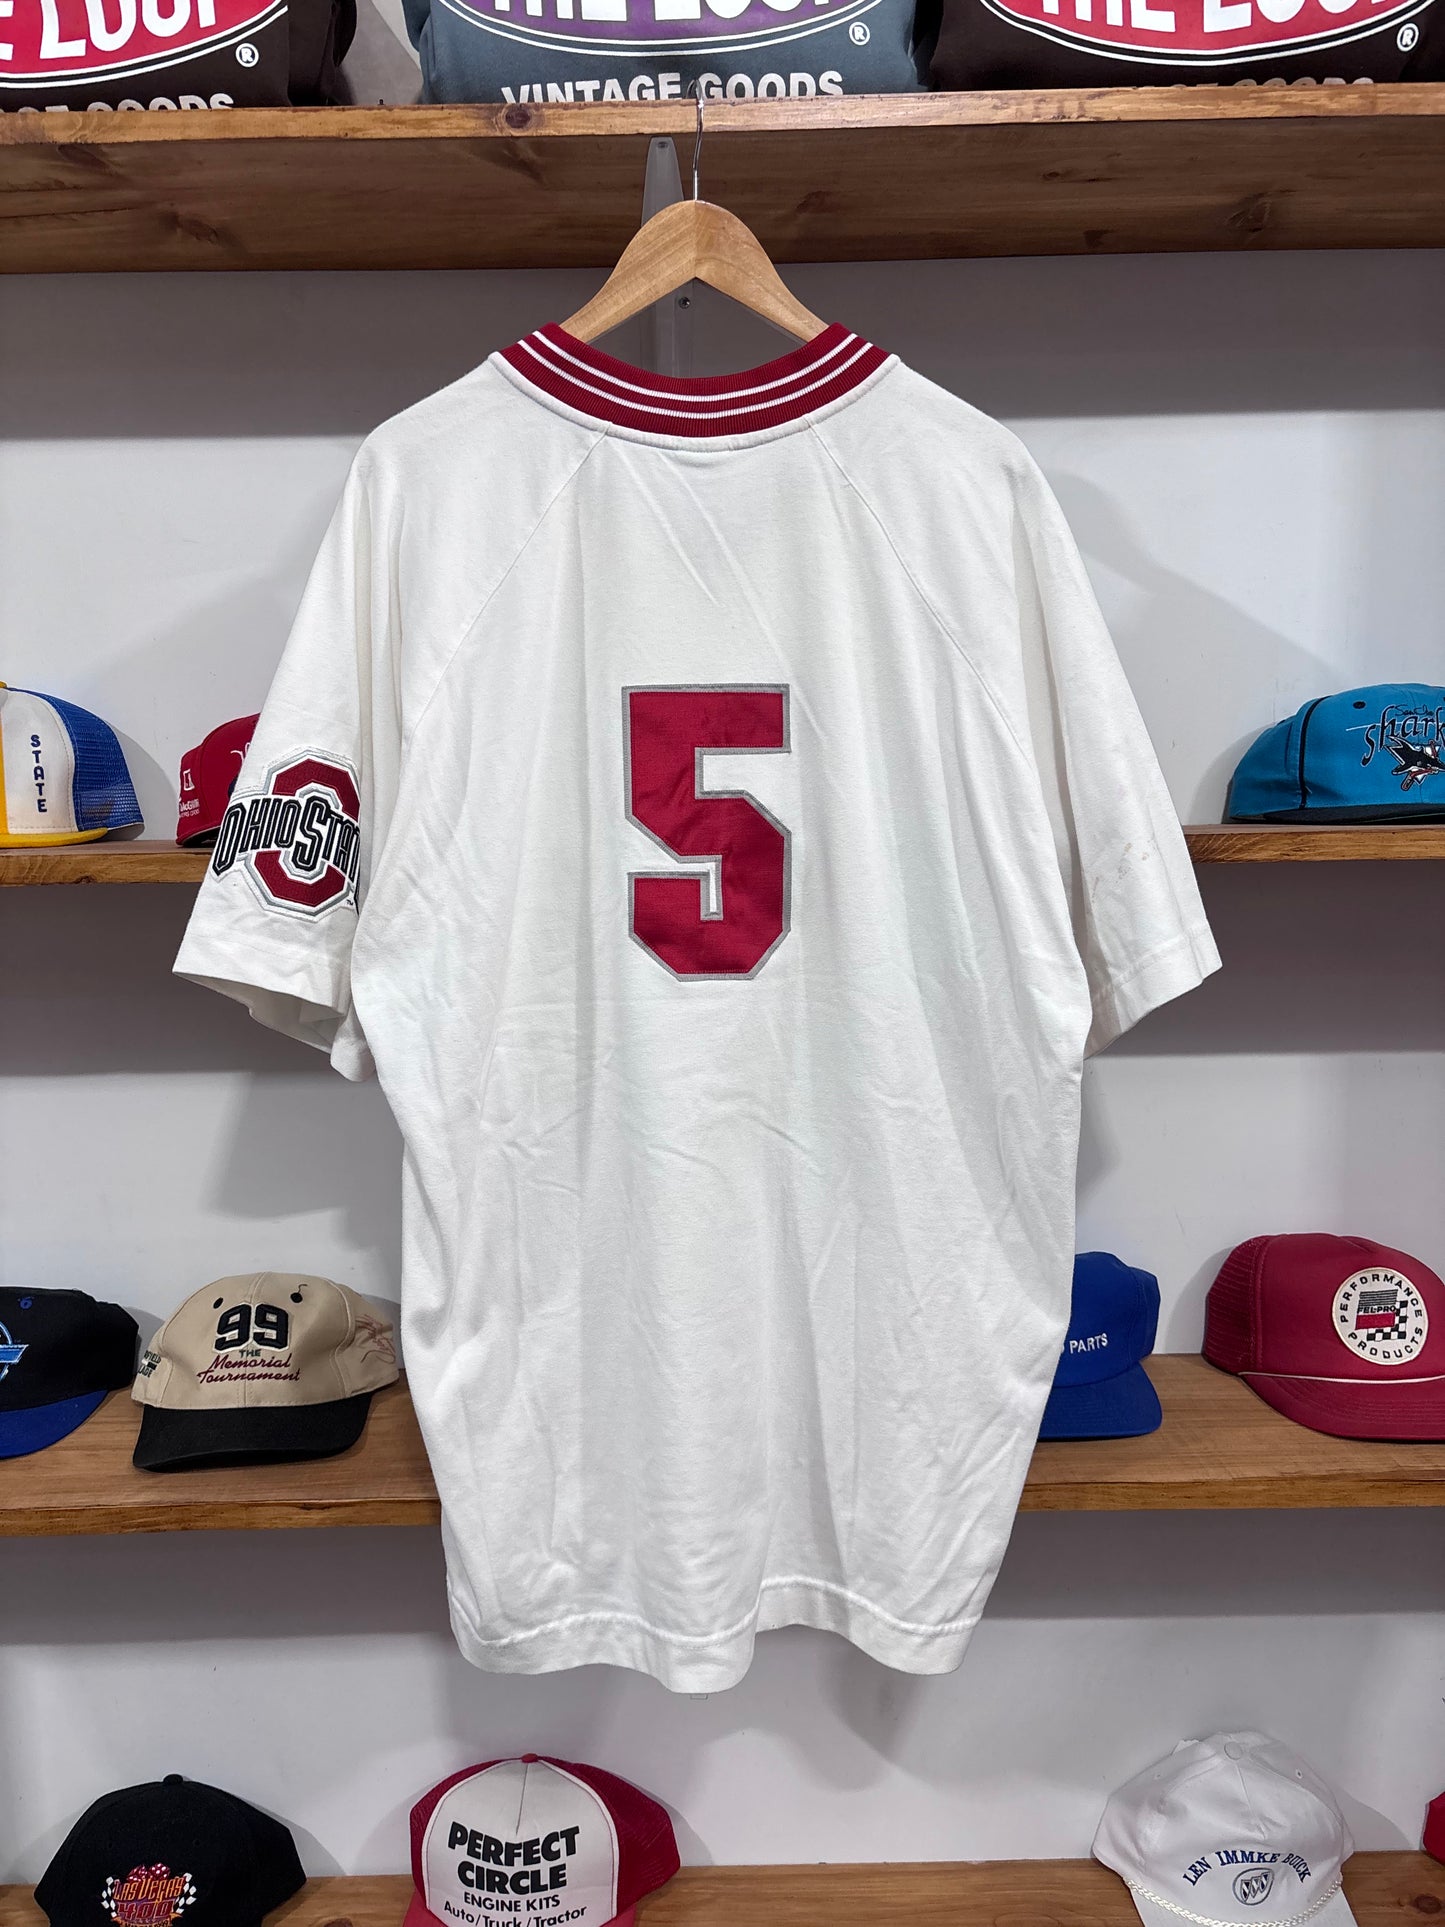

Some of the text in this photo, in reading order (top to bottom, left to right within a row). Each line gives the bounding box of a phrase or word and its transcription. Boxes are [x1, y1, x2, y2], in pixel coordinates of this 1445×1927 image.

[501, 70, 845, 104] VINTAGE GOODS
[30, 734, 48, 813] STATE
[621, 683, 793, 983] 5
[1339, 1273, 1423, 1323] PERFORMANCE
[214, 1303, 289, 1353] 99
[1069, 1332, 1109, 1355] PARTS
[1347, 1326, 1424, 1359] PRODUCTS
[207, 1352, 292, 1372] Memorial
[239, 1349, 261, 1358] THE
[196, 1367, 301, 1385] Tournament
[447, 1820, 580, 1867] PERFECT
[457, 1860, 567, 1895] CIRCLE
[1182, 1849, 1312, 1887] LEN IMMKE BUICK
[114, 1876, 185, 1903] LAS VEGAS
[464, 1891, 561, 1913] ENGINE KITS
[117, 1899, 176, 1921] 400
